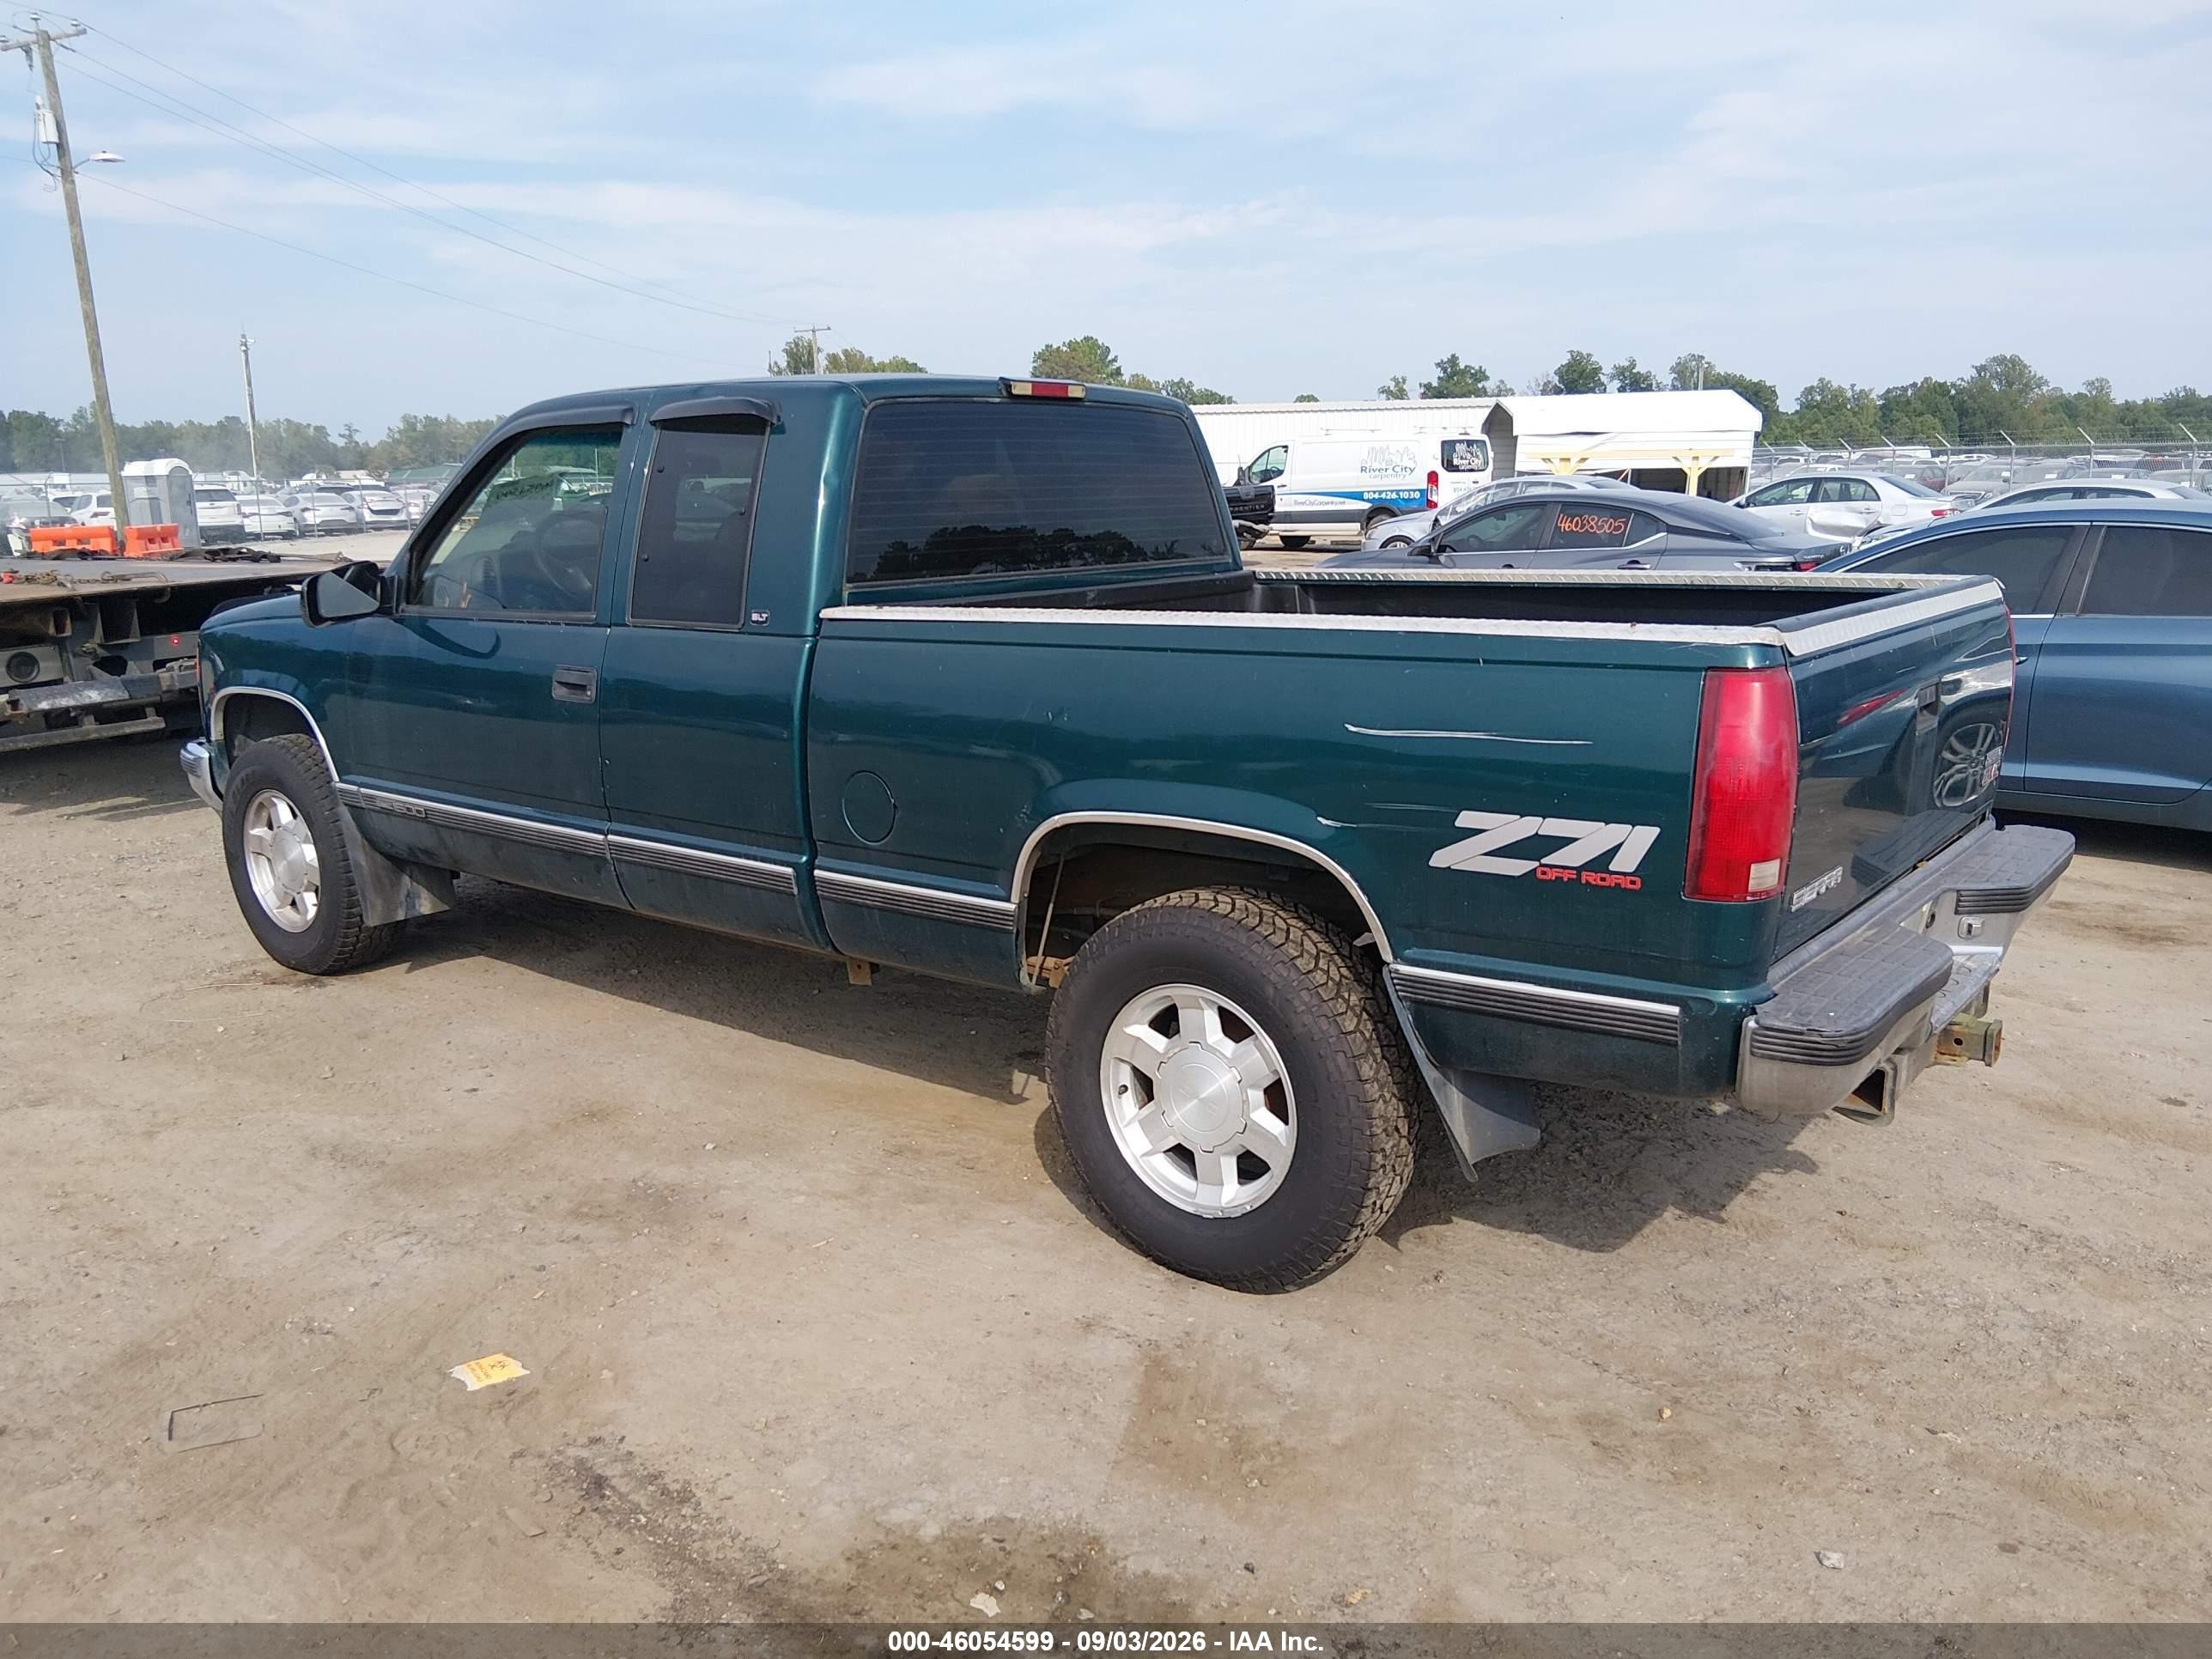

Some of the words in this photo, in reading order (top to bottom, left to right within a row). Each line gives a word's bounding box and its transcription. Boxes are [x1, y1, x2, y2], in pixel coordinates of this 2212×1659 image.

[1360, 465, 1388, 474] River
[1392, 465, 1415, 476] City
[1369, 472, 1407, 481] carpentry
[1557, 514, 1626, 534] 46038505
[1428, 810, 1661, 876] Z71
[1535, 866, 1577, 883] OFF
[1580, 871, 1642, 890] ROAD
